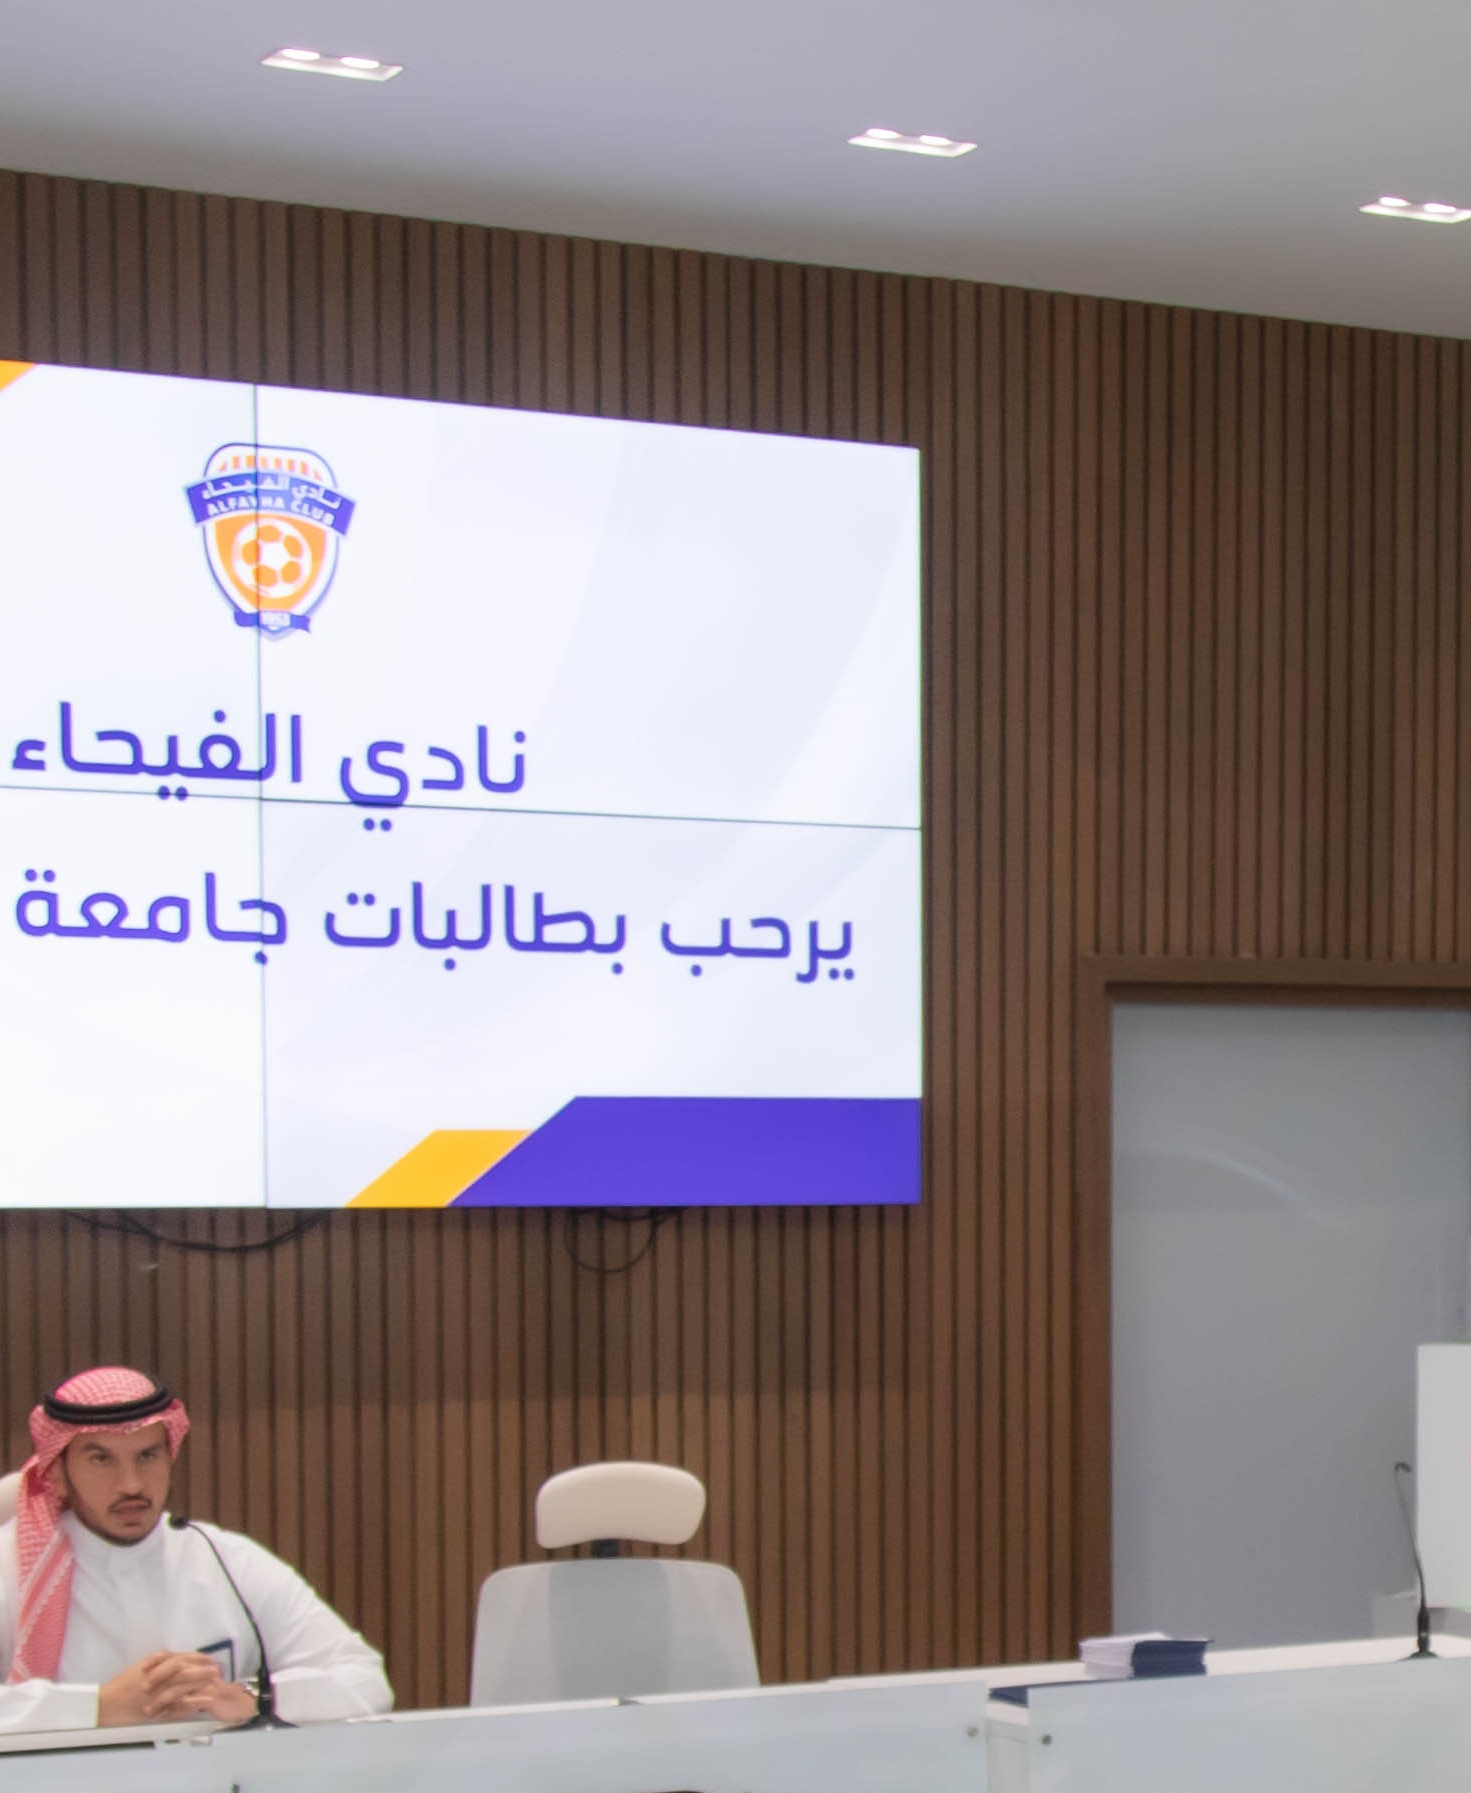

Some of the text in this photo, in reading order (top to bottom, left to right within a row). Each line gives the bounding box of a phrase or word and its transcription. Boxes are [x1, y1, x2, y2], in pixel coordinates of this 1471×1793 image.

[290, 496, 336, 526] CLUB
[12, 701, 527, 833] نادي الفيحاء
[15, 868, 288, 966] جامعة
[325, 881, 627, 975] بطالبات
[661, 917, 855, 984] يرحب
